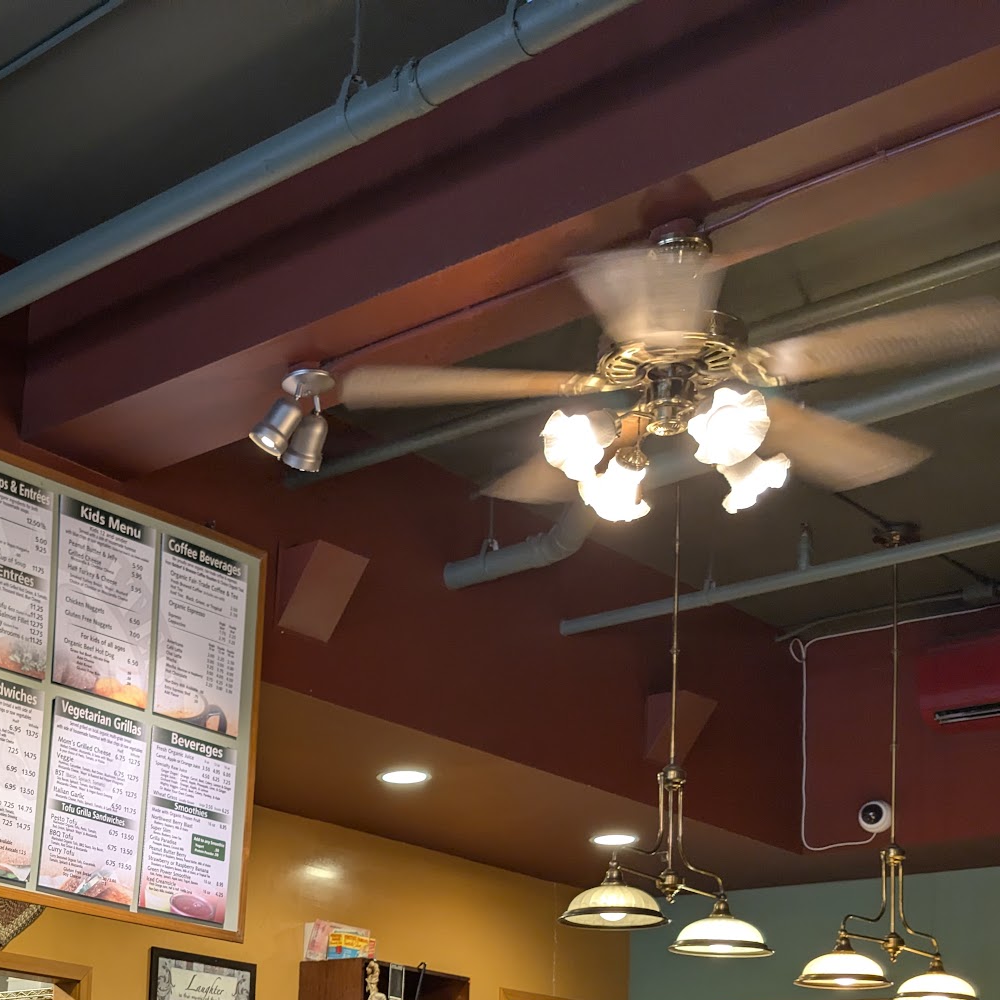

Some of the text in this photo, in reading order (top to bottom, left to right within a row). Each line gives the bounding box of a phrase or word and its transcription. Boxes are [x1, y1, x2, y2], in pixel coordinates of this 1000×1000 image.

[10, 479, 17, 493] &
[19, 483, 51, 506] Entrées
[80, 505, 141, 538] Kids Menu
[167, 538, 242, 580] Coffee Beverages
[63, 636, 82, 648] Organic
[83, 643, 94, 651] Beef
[104, 649, 114, 660] Dog
[61, 699, 142, 737] Vegetarian Grillas
[169, 732, 222, 758] Beverages
[61, 802, 125, 826] Tofu Grilla Sandwiches
[173, 801, 207, 817] Smoothies
